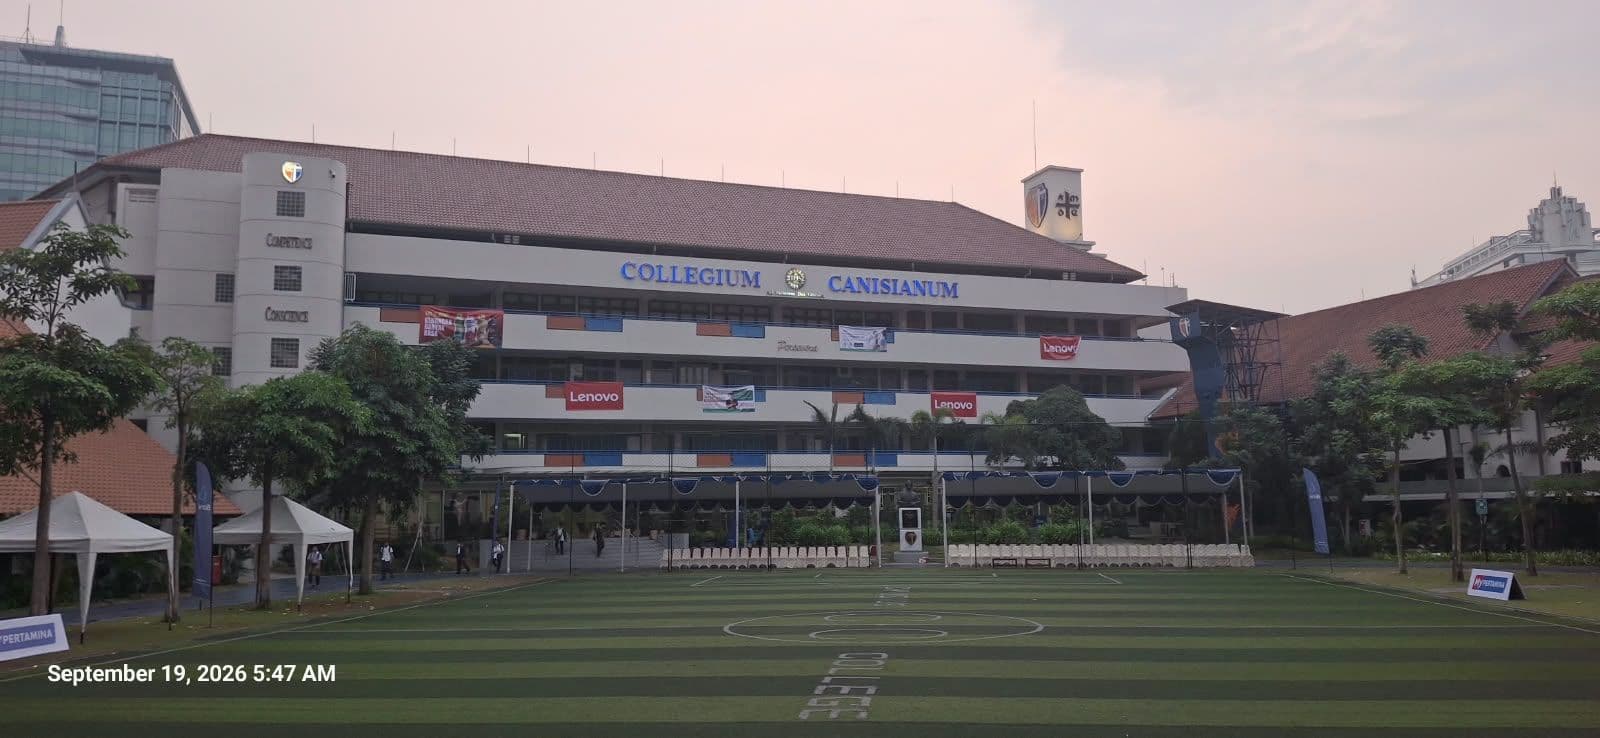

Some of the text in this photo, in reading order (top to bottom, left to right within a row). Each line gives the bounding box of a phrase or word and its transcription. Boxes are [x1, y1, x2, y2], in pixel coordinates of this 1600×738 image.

[620, 261, 761, 288] COLLEGIUM
[828, 275, 960, 299] CANISIANUM
[570, 391, 619, 402] Lenovo
[934, 399, 973, 410] Lenovo
[0, 629, 53, 645] PERTAMINA
